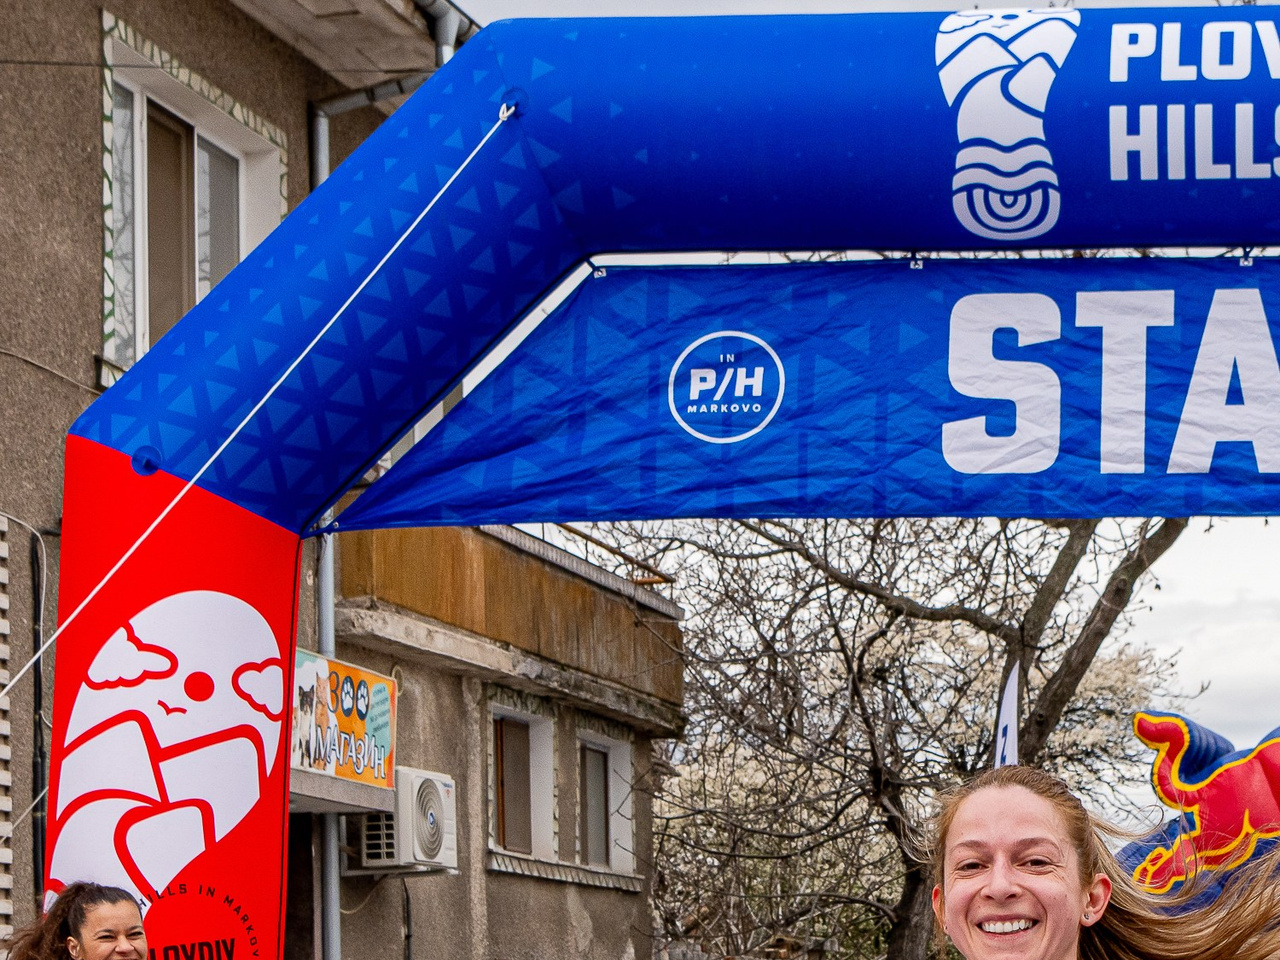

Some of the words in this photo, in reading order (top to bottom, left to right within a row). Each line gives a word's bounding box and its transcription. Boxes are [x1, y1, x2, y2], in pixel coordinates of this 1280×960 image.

[719, 354, 735, 363] IN
[690, 367, 764, 401] P/H
[687, 403, 762, 414] MARKOVO
[315, 724, 386, 779] МАГАЗИН
[199, 885, 216, 898] IN
